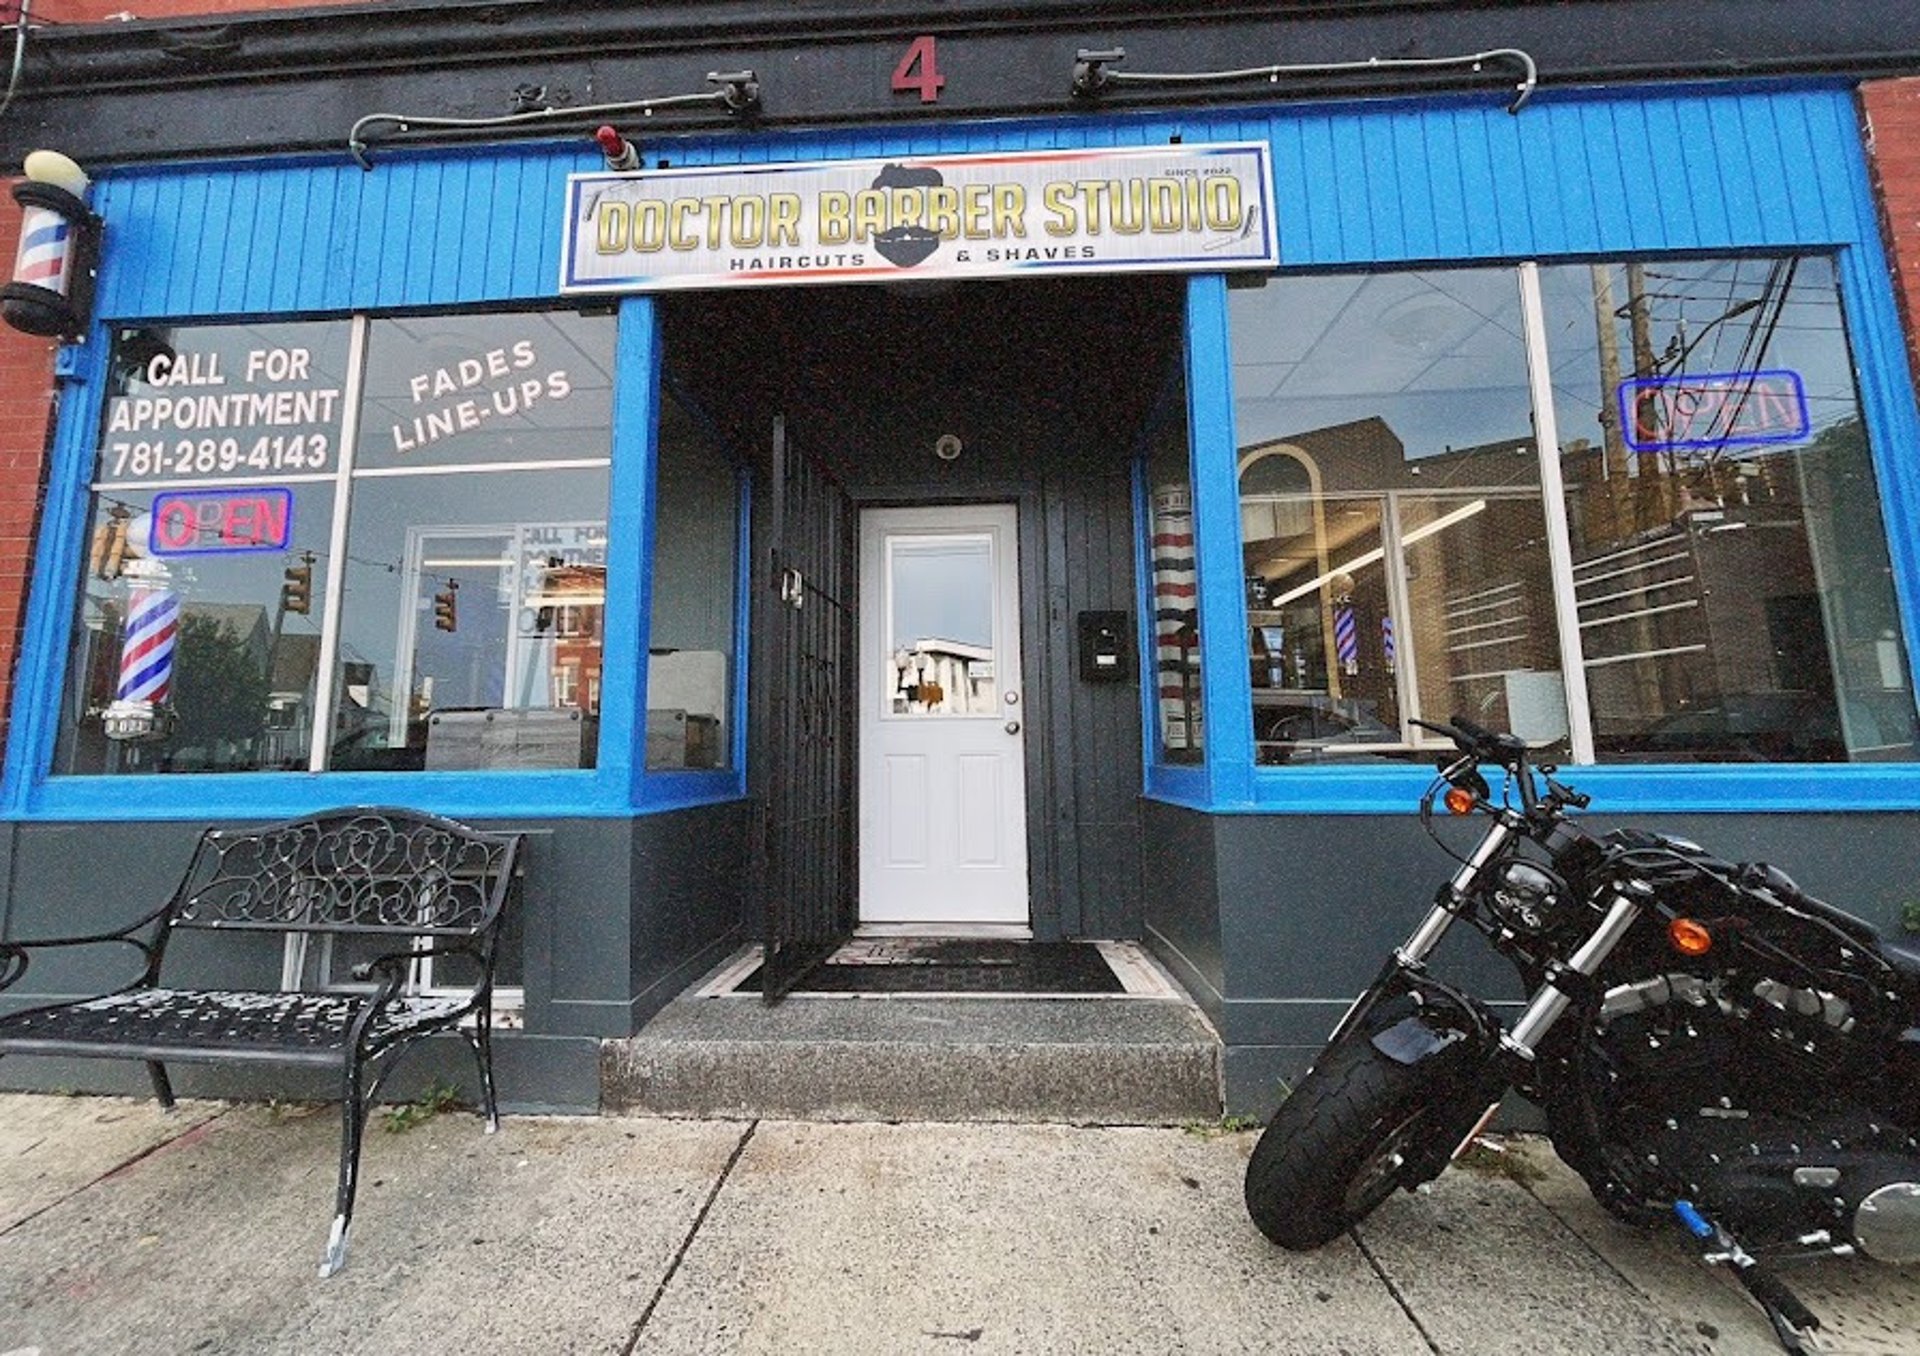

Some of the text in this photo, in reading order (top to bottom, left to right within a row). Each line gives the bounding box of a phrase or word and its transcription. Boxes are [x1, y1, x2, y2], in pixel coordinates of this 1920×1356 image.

[891, 35, 945, 101] 4
[595, 176, 1242, 255] DOCTOR BARBER STUDIO
[730, 246, 1096, 271] HAIRCUTS & SHAVES
[148, 348, 310, 386] CALL FOR
[410, 340, 536, 403] FADES
[110, 389, 339, 432] APPOINTMENT
[392, 370, 571, 451] LINE-UPS
[1632, 382, 1799, 439] OPEN
[113, 434, 328, 476] 781-289-4143
[158, 496, 287, 549] OPEN
